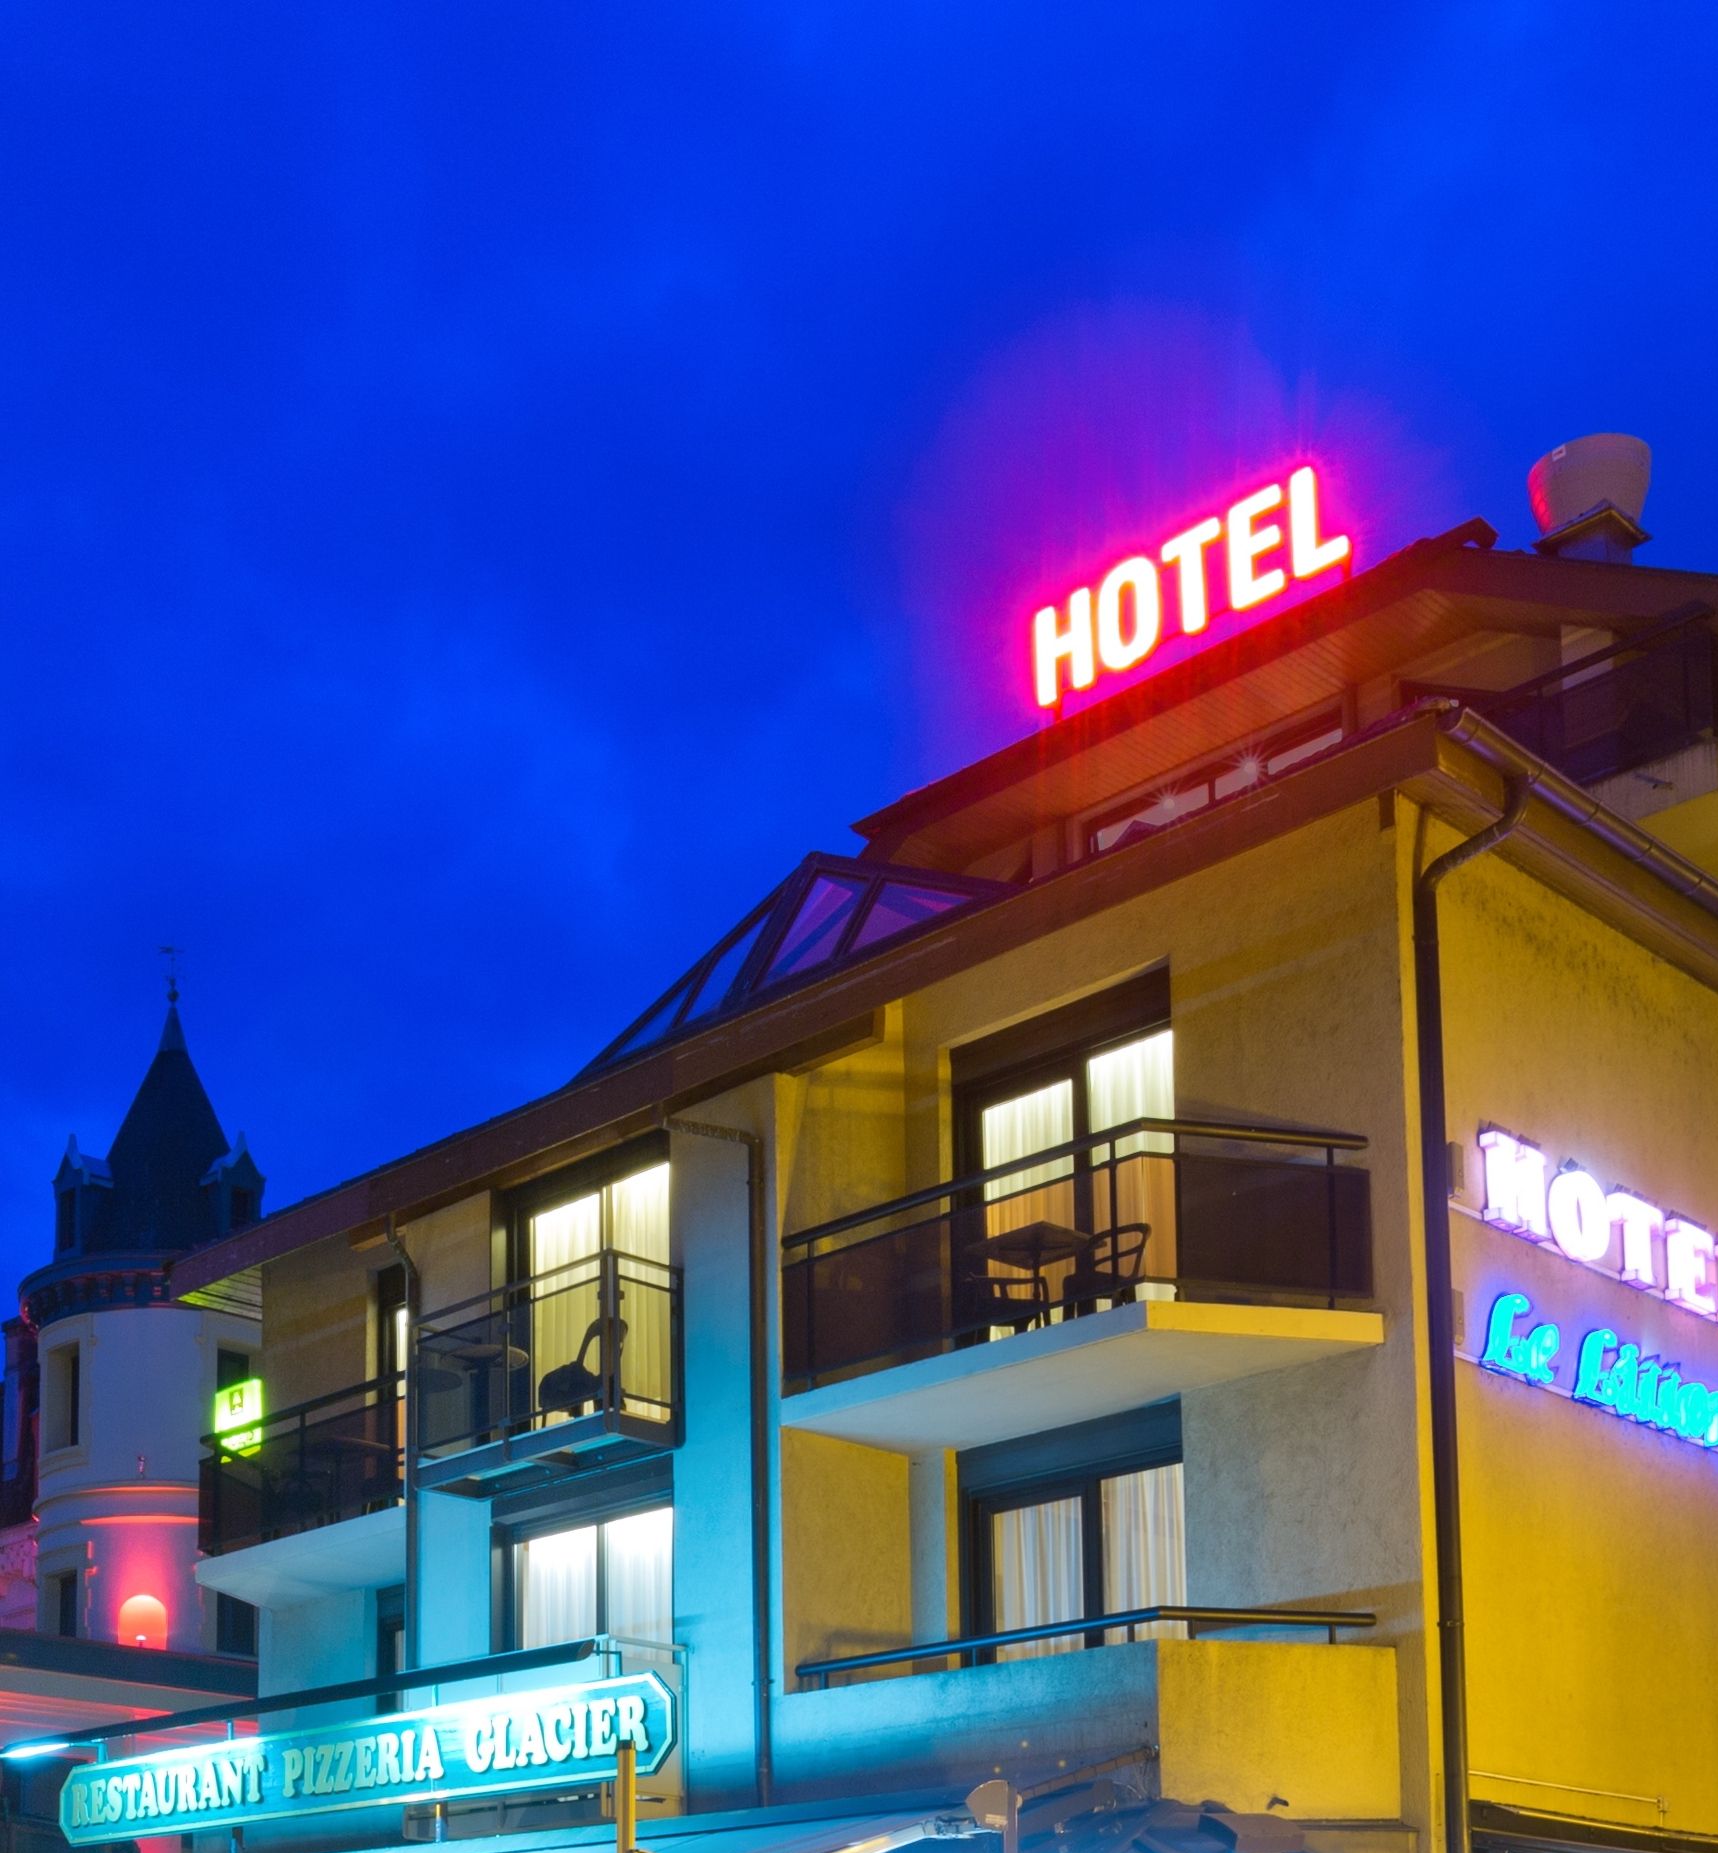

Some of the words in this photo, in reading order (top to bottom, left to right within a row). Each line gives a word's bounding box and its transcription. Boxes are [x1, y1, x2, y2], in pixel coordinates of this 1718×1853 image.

[1033, 465, 1350, 708] HOTEL
[1480, 1293, 1560, 1384] Le
[70, 1753, 265, 1829] RESTAURANT
[281, 1724, 445, 1798] PIZZERIA
[464, 1695, 649, 1774] GLACIER
